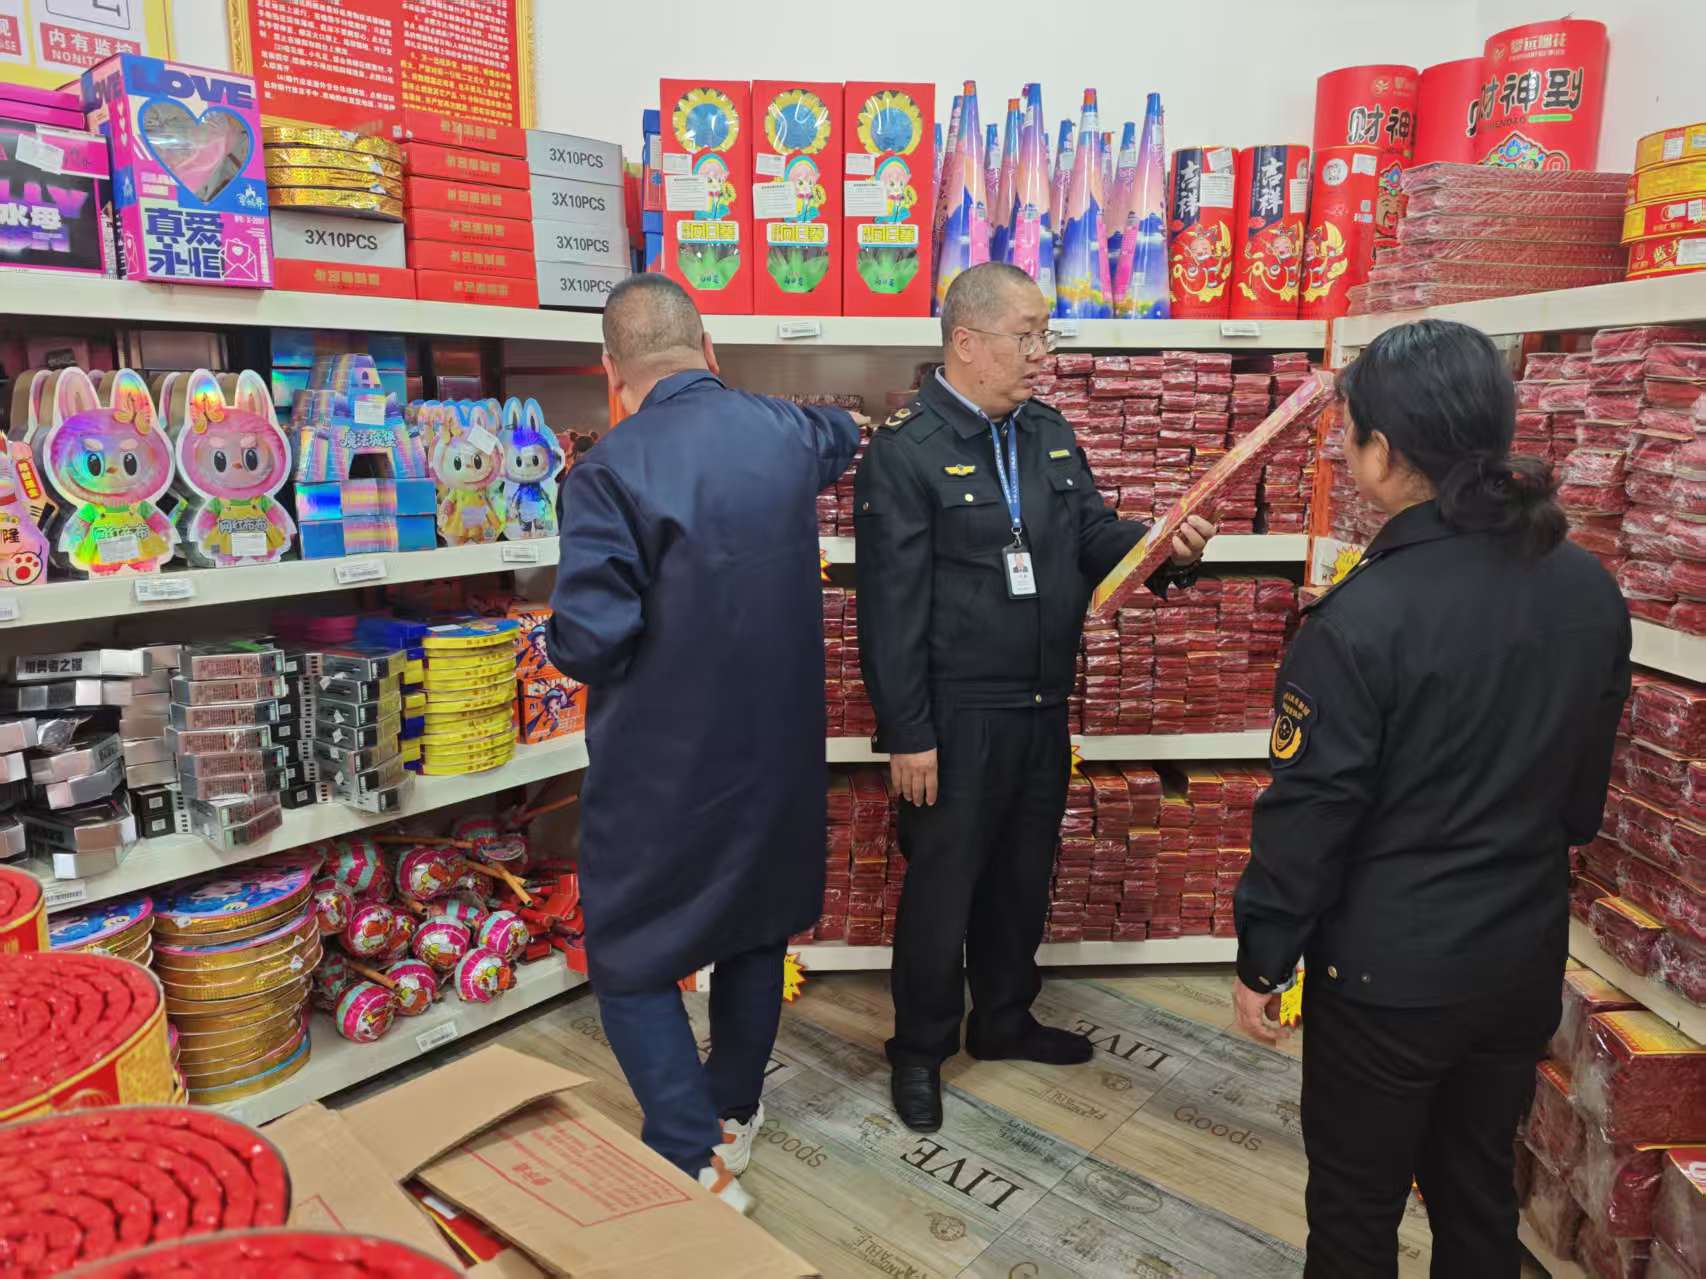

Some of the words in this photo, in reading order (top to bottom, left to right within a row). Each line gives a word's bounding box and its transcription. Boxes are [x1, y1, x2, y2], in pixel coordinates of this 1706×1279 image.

[132, 63, 253, 110] LOVE
[1348, 103, 1417, 145] 财神
[550, 146, 605, 174] 3X10PCS
[552, 191, 606, 217] 3X10PCS
[305, 229, 378, 255] 3X10PCS
[557, 236, 609, 259] 3X10PCS
[561, 277, 612, 299] 3X10PCS
[1075, 1019, 1173, 1072] LIVE
[759, 1118, 827, 1169] Goods
[1173, 1106, 1262, 1151] Goods
[900, 1137, 1024, 1212] LIVE
